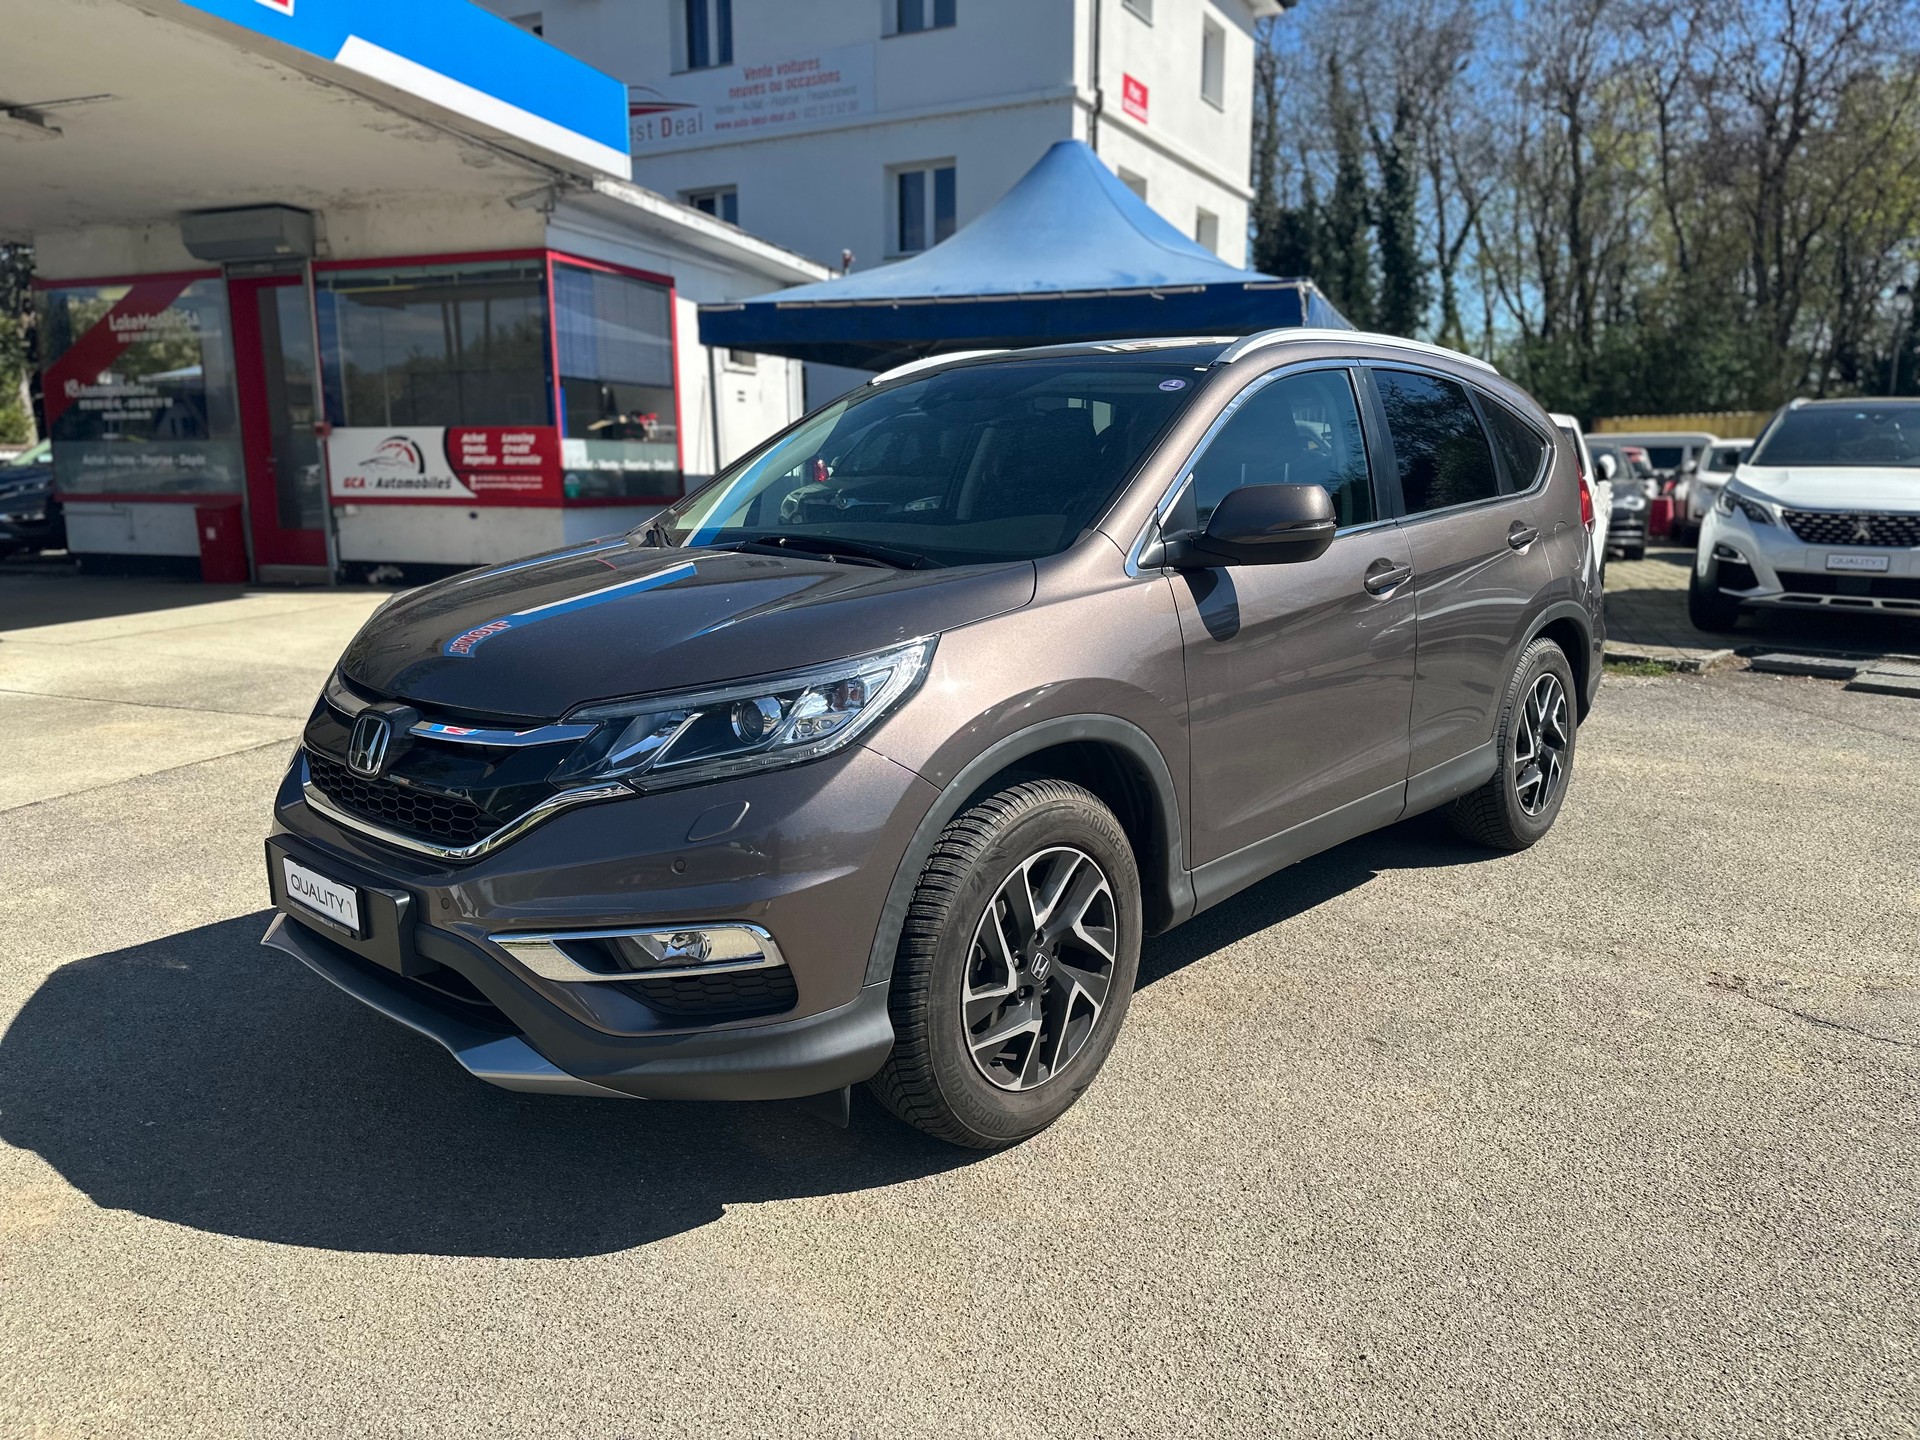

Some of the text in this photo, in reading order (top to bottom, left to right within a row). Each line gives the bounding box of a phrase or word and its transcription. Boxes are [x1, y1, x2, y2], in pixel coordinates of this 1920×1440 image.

[743, 57, 821, 81] Vente voitures
[728, 69, 841, 98] neuves ou occasions
[629, 111, 704, 142] est Deal
[343, 477, 366, 489] GCA
[375, 476, 452, 490] Automobiles
